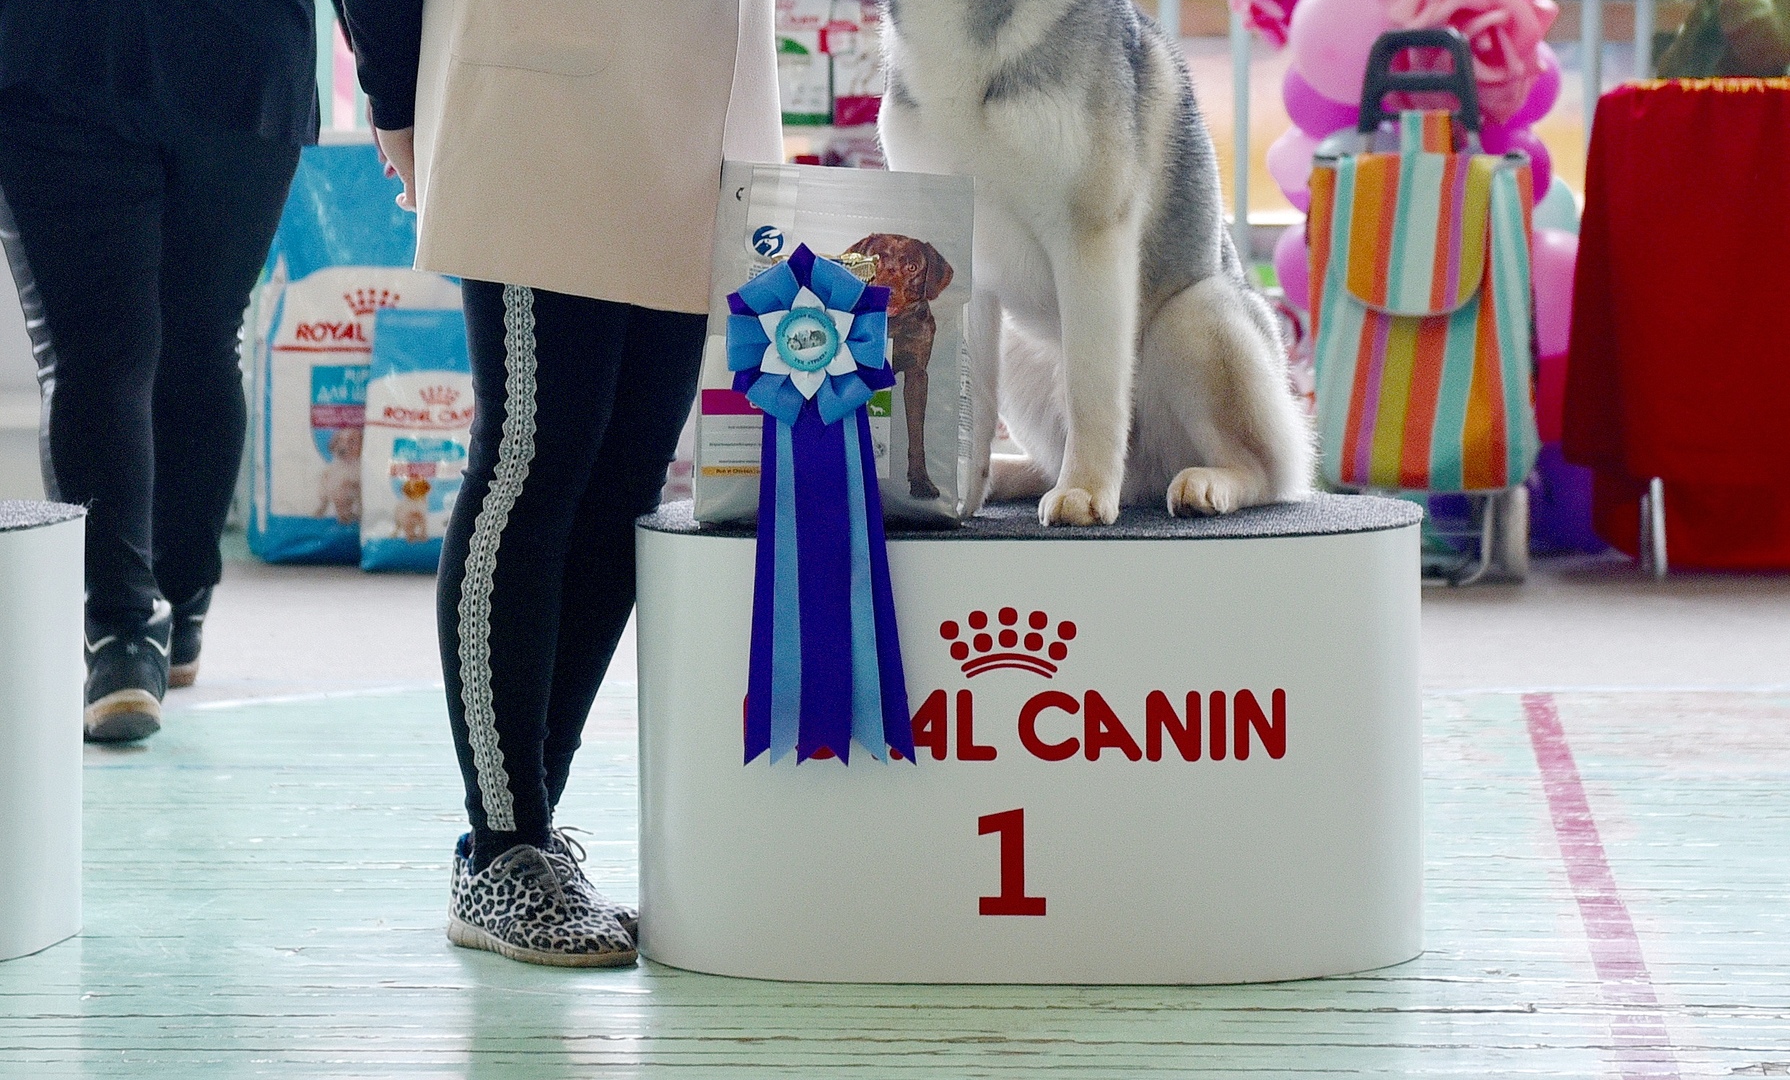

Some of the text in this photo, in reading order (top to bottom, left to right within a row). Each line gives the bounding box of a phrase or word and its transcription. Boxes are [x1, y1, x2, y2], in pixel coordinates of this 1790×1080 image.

[296, 322, 367, 342] ROYAL
[383, 406, 430, 422] ROYAL
[1018, 688, 1286, 762] CANIN
[978, 807, 1047, 916] 1
